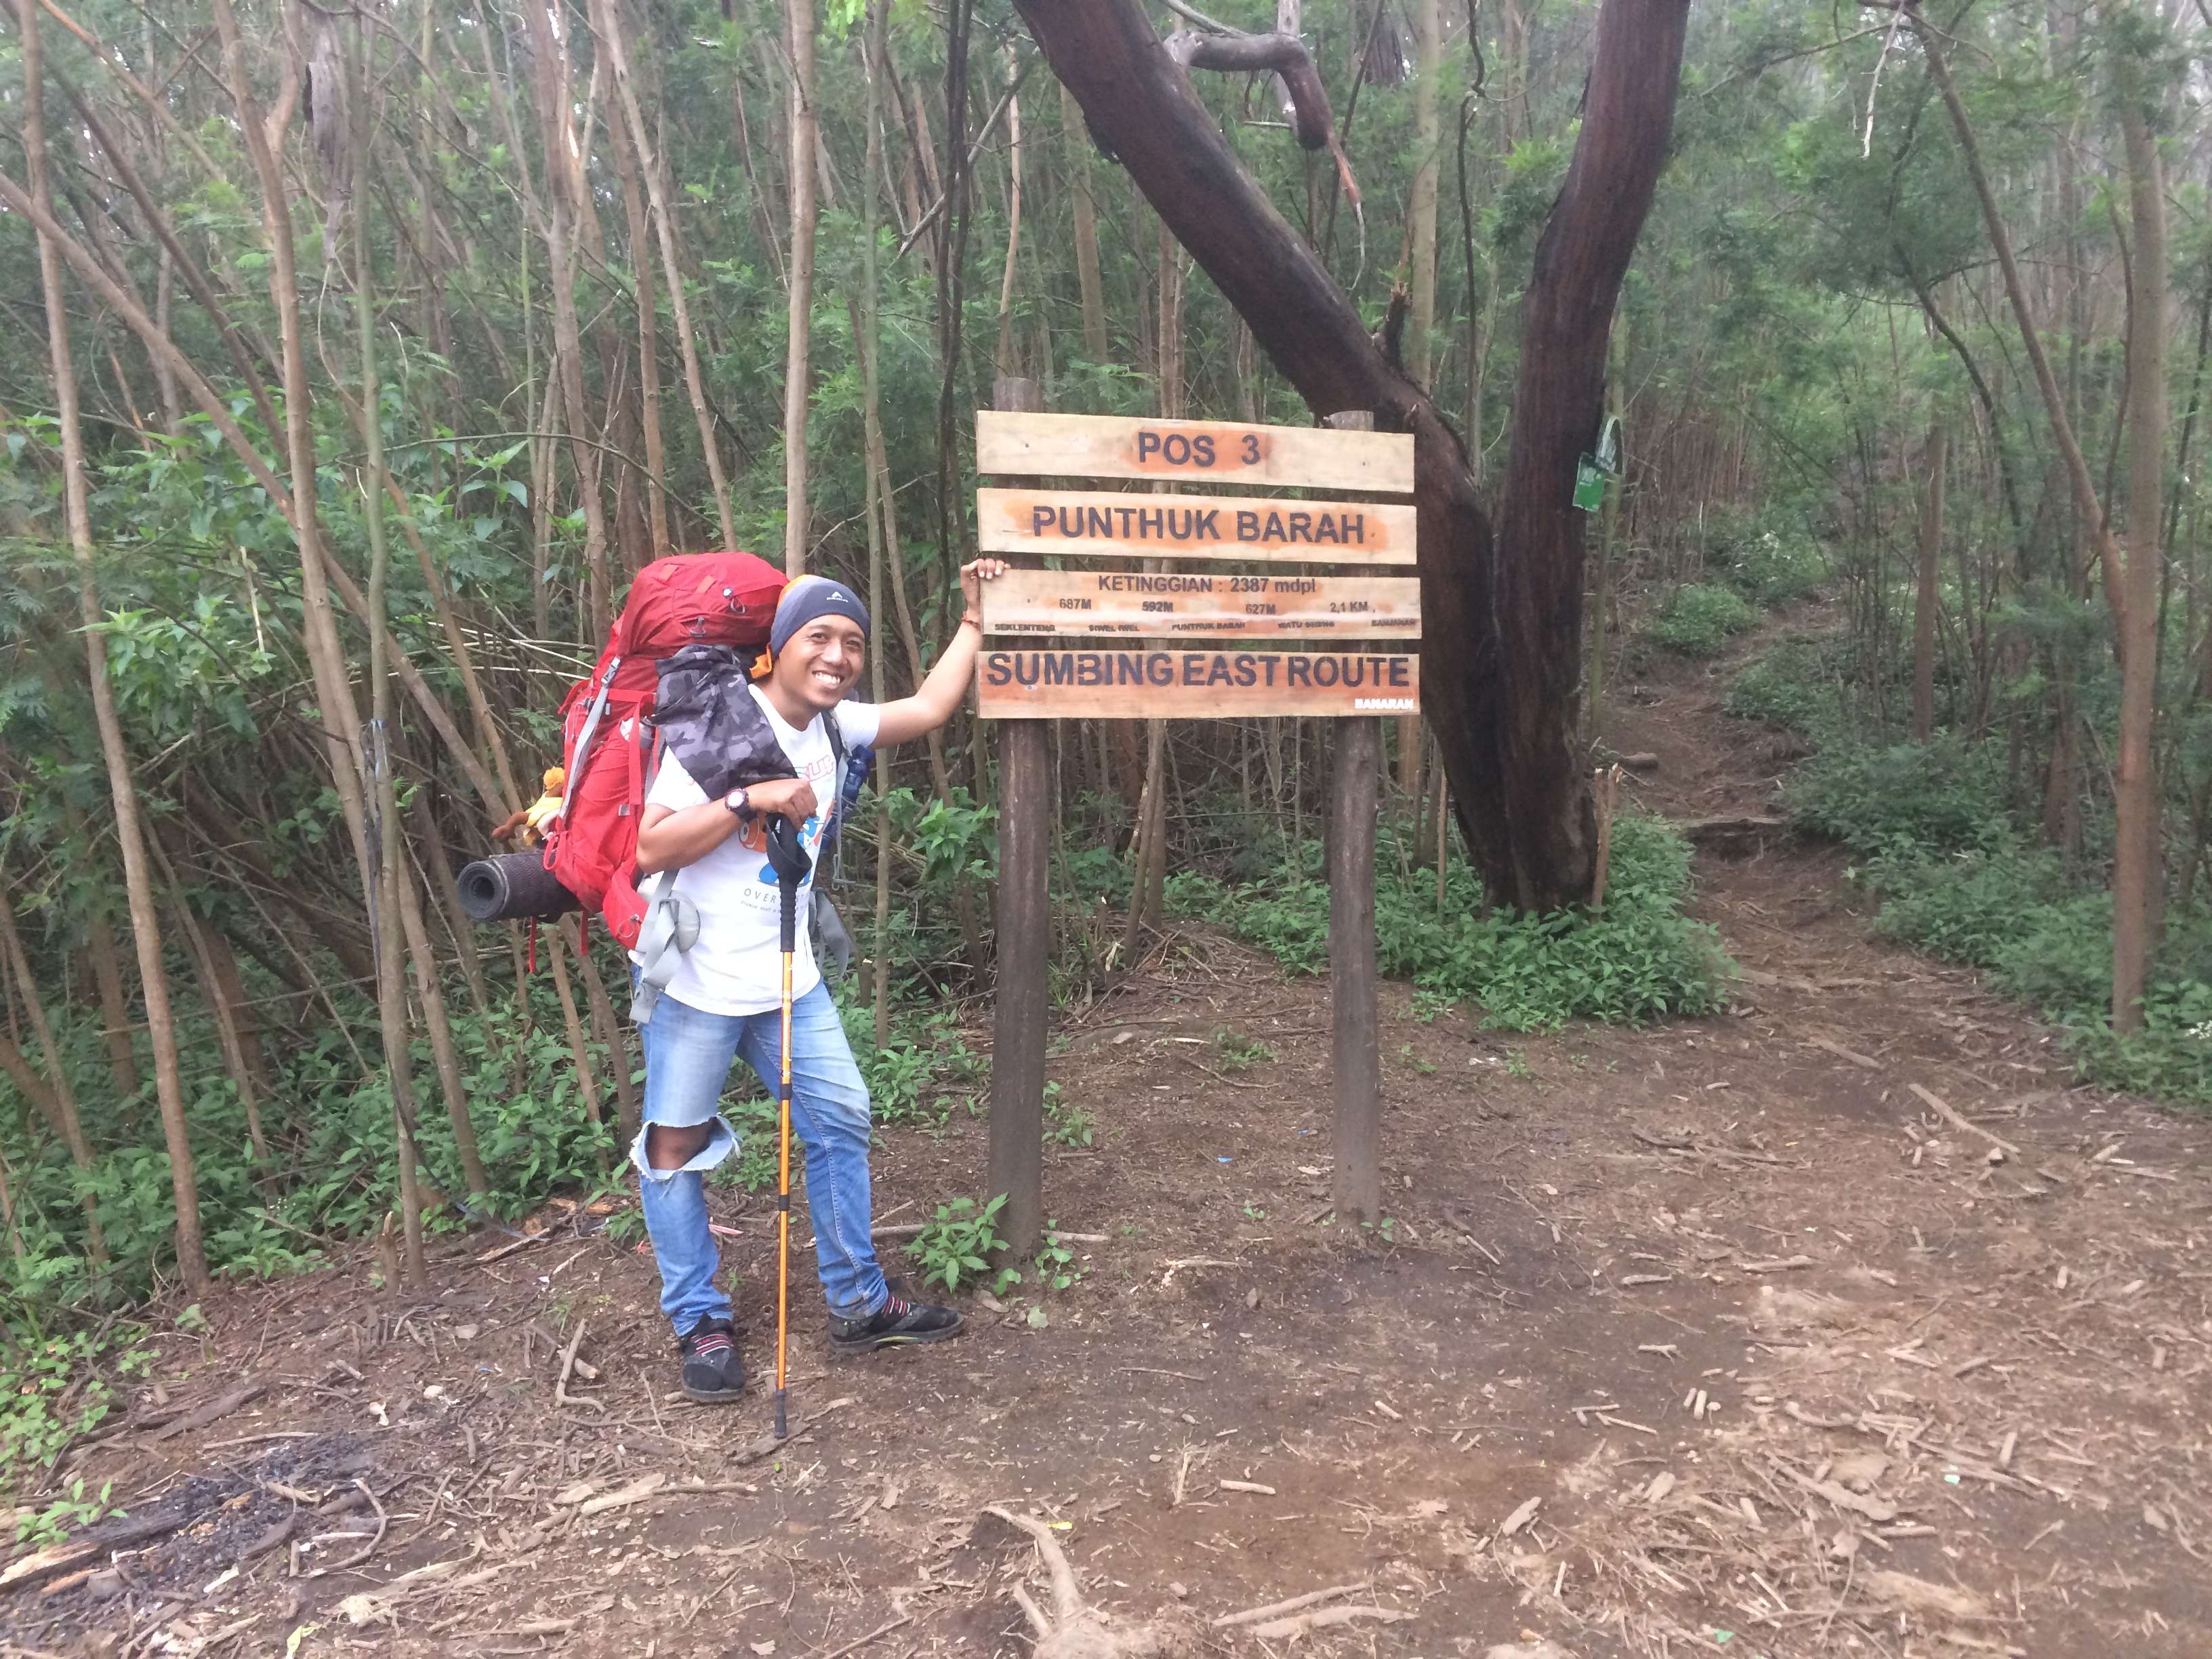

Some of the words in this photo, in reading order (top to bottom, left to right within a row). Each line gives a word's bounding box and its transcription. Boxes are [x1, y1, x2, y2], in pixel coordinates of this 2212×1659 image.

[1139, 432, 1216, 467] POS
[1241, 434, 1260, 465] 3
[1033, 506, 1221, 540] PUNTHUK
[1237, 510, 1364, 544] BARAH
[1099, 575, 1212, 592] KETINGGIAN
[1230, 577, 1269, 593] 2387
[1275, 578, 1315, 595] mdpl
[1059, 598, 1092, 609] 687M
[1142, 600, 1173, 612] 592M
[1246, 604, 1276, 615] 627M
[987, 653, 1173, 687] SUMBING
[1183, 654, 1280, 687] EAST
[1288, 656, 1410, 687] ROUTE
